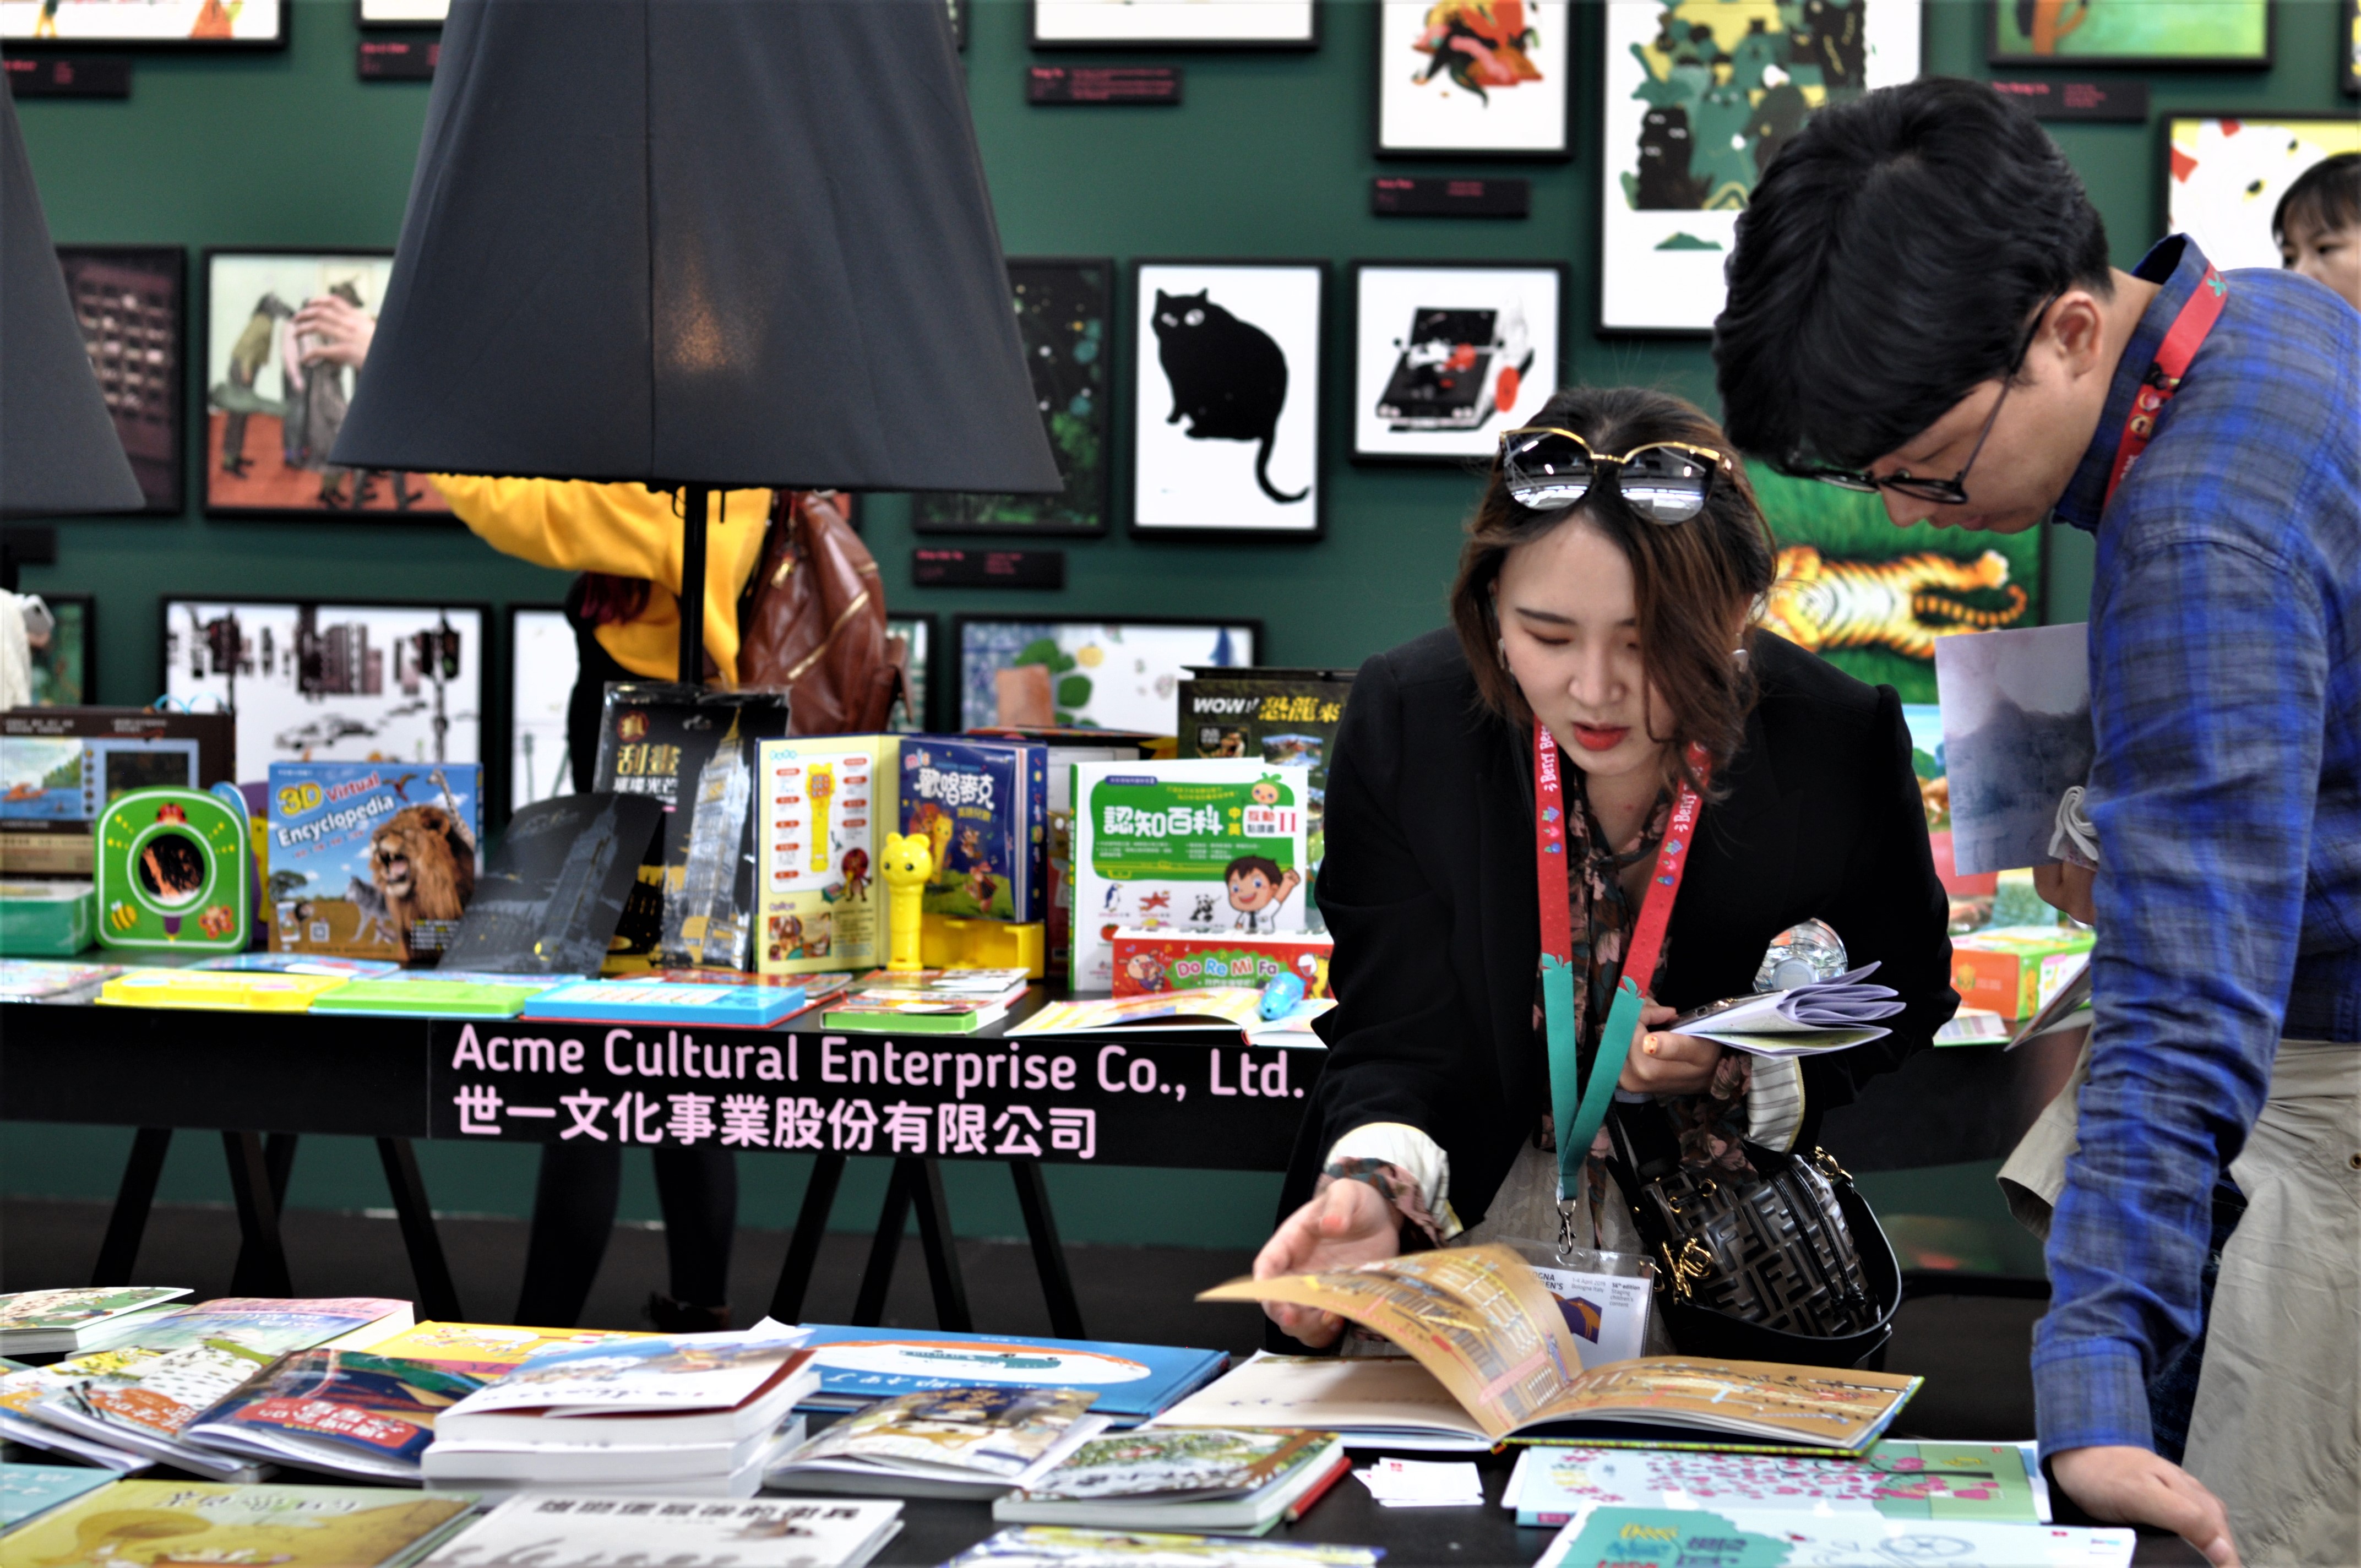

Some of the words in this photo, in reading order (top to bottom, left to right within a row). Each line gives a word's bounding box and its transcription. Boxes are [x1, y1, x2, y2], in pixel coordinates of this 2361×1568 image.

[278, 781, 323, 818] 3D
[325, 771, 381, 803] Virtual
[913, 767, 995, 810] 歡唱麥克
[277, 796, 394, 848] Encyclopedia
[1103, 804, 1223, 837] 認知百科
[1176, 961, 1201, 978] Do
[1205, 958, 1227, 977] Re
[1231, 957, 1254, 976] Mi
[1258, 960, 1279, 976] Fa
[453, 1024, 584, 1074] Acme
[605, 1029, 798, 1081] Cultural
[822, 1037, 1075, 1099] Enterprise
[1098, 1045, 1186, 1102] Co.,
[1211, 1048, 1304, 1098] Ltd.
[454, 1085, 1095, 1159] 世一文化事業股份有限公司
[1571, 1284, 1592, 1292] Bologna
